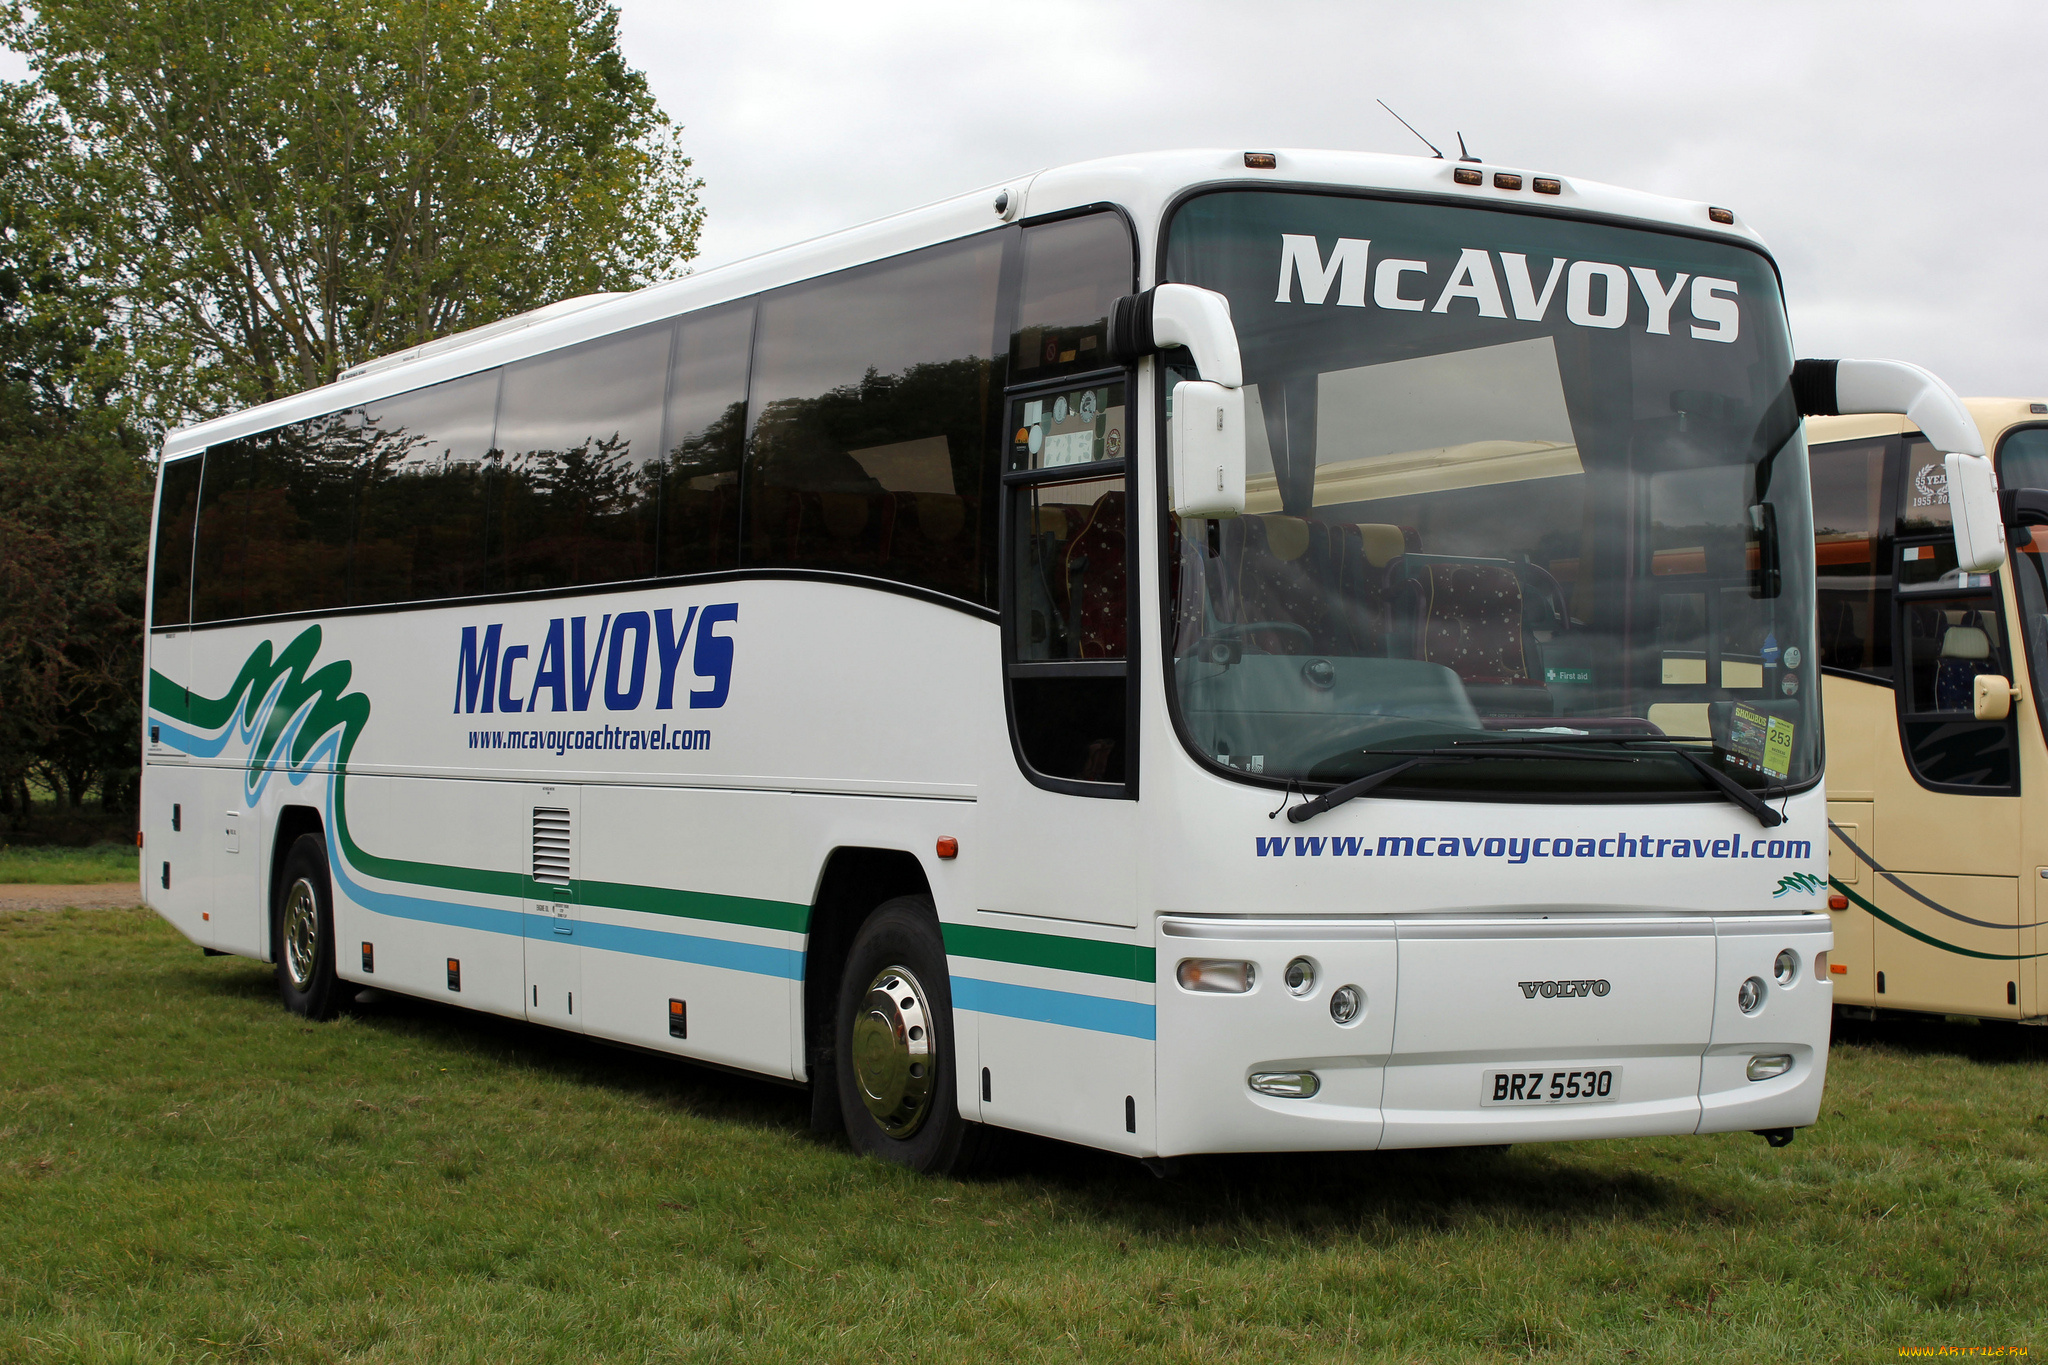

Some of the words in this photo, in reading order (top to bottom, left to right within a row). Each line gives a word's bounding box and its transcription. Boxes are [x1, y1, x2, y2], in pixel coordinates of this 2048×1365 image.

[1274, 233, 1740, 344] McAVOYS
[1915, 477, 1926, 486] 55
[1926, 474, 1948, 486] YEA
[1913, 496, 1931, 507] 1955
[1938, 495, 1950, 504] 20
[453, 602, 739, 714] McAVOYS
[1559, 671, 1576, 680] First
[1576, 672, 1588, 680] aid
[1735, 707, 1767, 727] SHOWBUS
[468, 723, 711, 756] www.mcavoycoachtravel.com
[1769, 729, 1791, 748] 253
[1254, 832, 1812, 864] www.mcavoycoachtravel.com
[1518, 979, 1611, 999] VOLVO
[1493, 1073, 1544, 1101] BRZ
[1549, 1070, 1613, 1099] 5530
